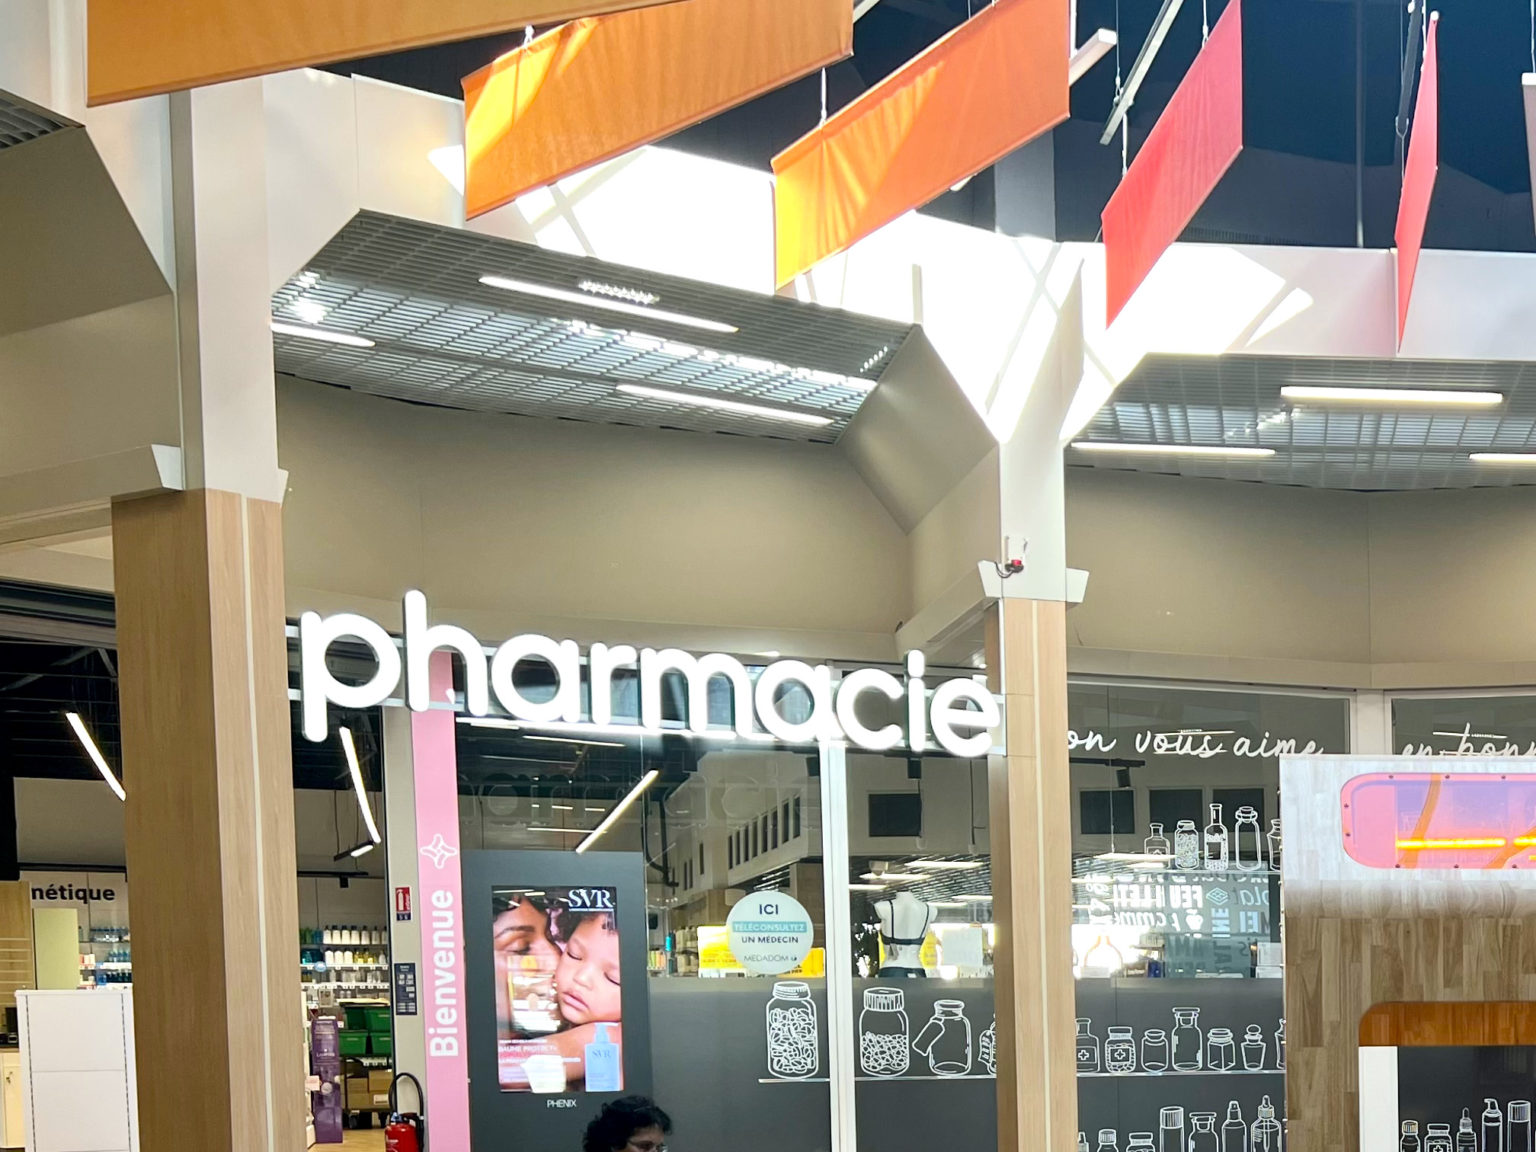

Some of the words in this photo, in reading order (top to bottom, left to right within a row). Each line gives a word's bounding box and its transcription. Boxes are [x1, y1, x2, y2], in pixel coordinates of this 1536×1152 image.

[300, 589, 1001, 758] pharmacie
[1135, 731, 1223, 758] vous
[1234, 731, 1324, 757] aime
[568, 888, 614, 908] SVR
[759, 904, 779, 915] ICI
[428, 890, 459, 1057] Bienvenue
[547, 1099, 577, 1108] PHENIX
